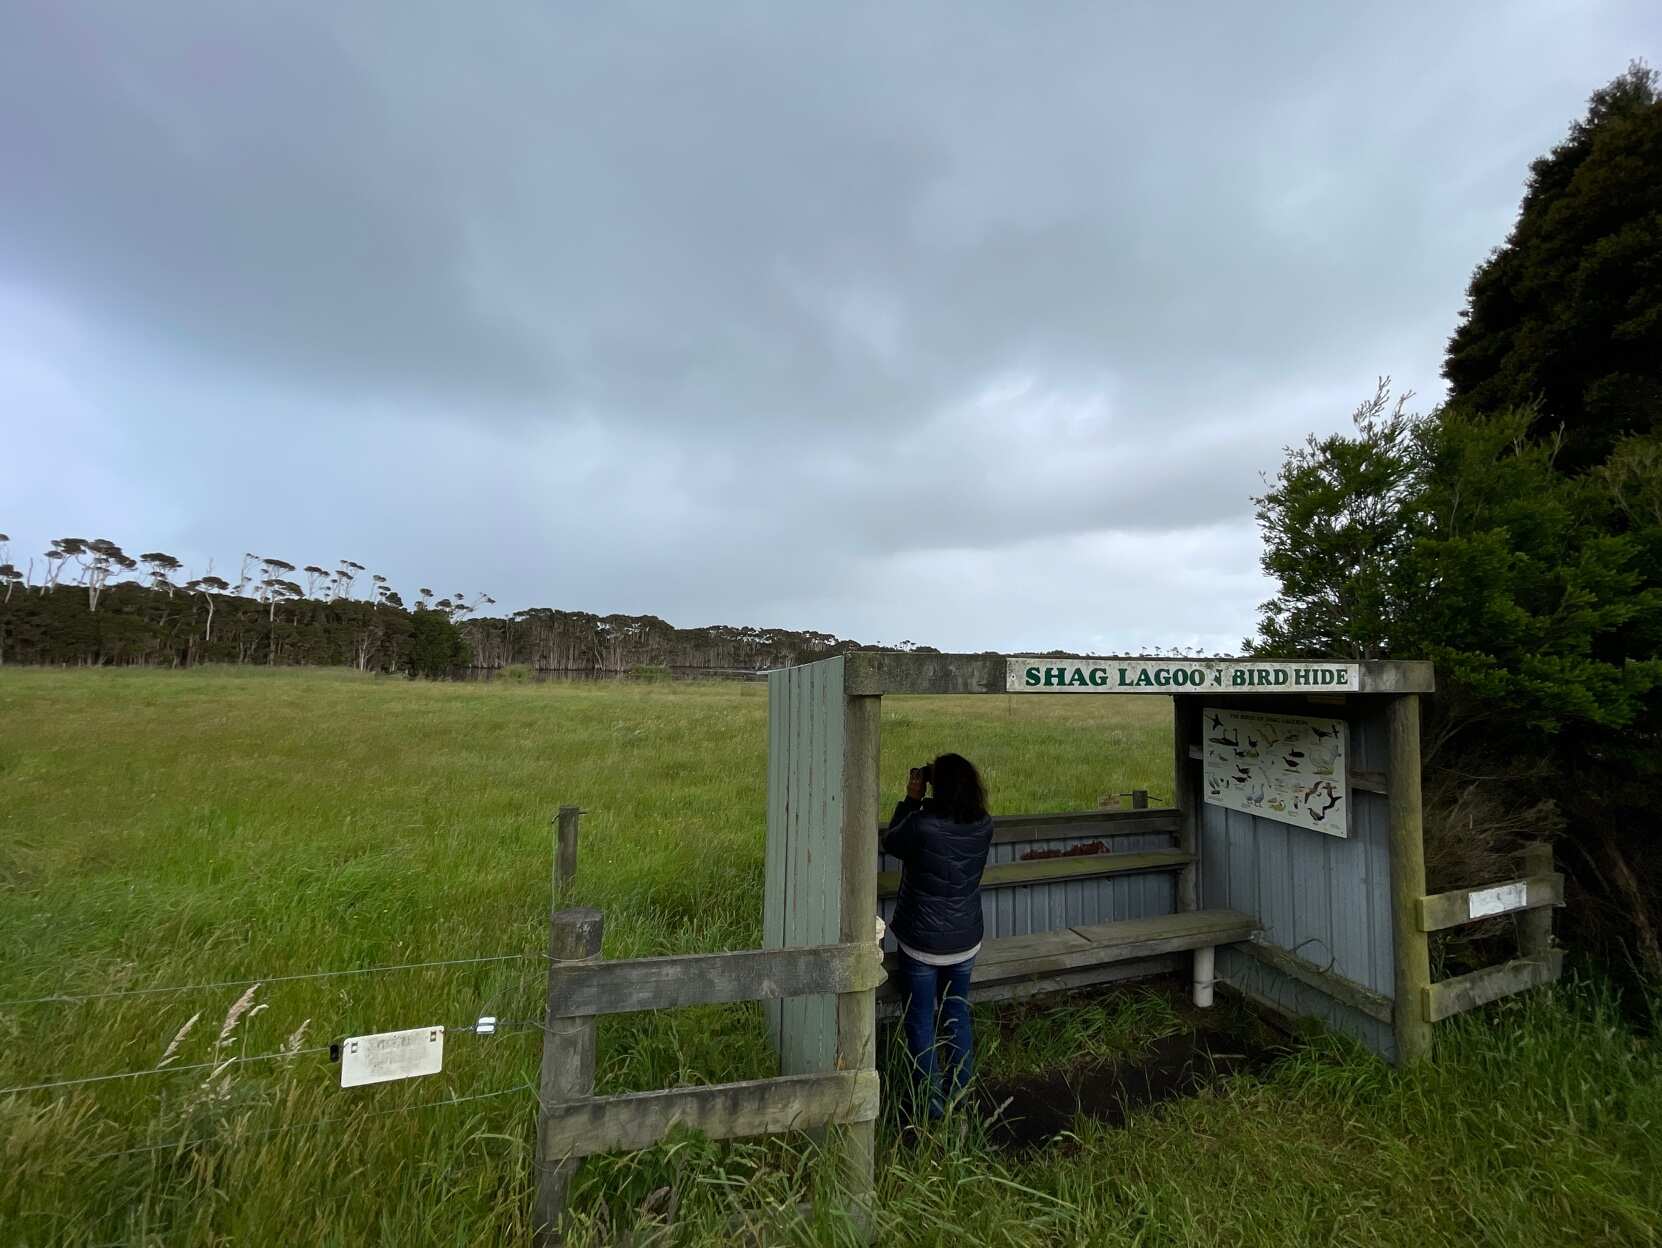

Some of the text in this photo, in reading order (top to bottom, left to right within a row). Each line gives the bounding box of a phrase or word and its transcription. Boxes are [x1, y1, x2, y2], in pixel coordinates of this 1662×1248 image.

[1025, 667, 1108, 687] SHAG
[1232, 668, 1289, 686] BIRD
[1294, 668, 1348, 685] HIDE
